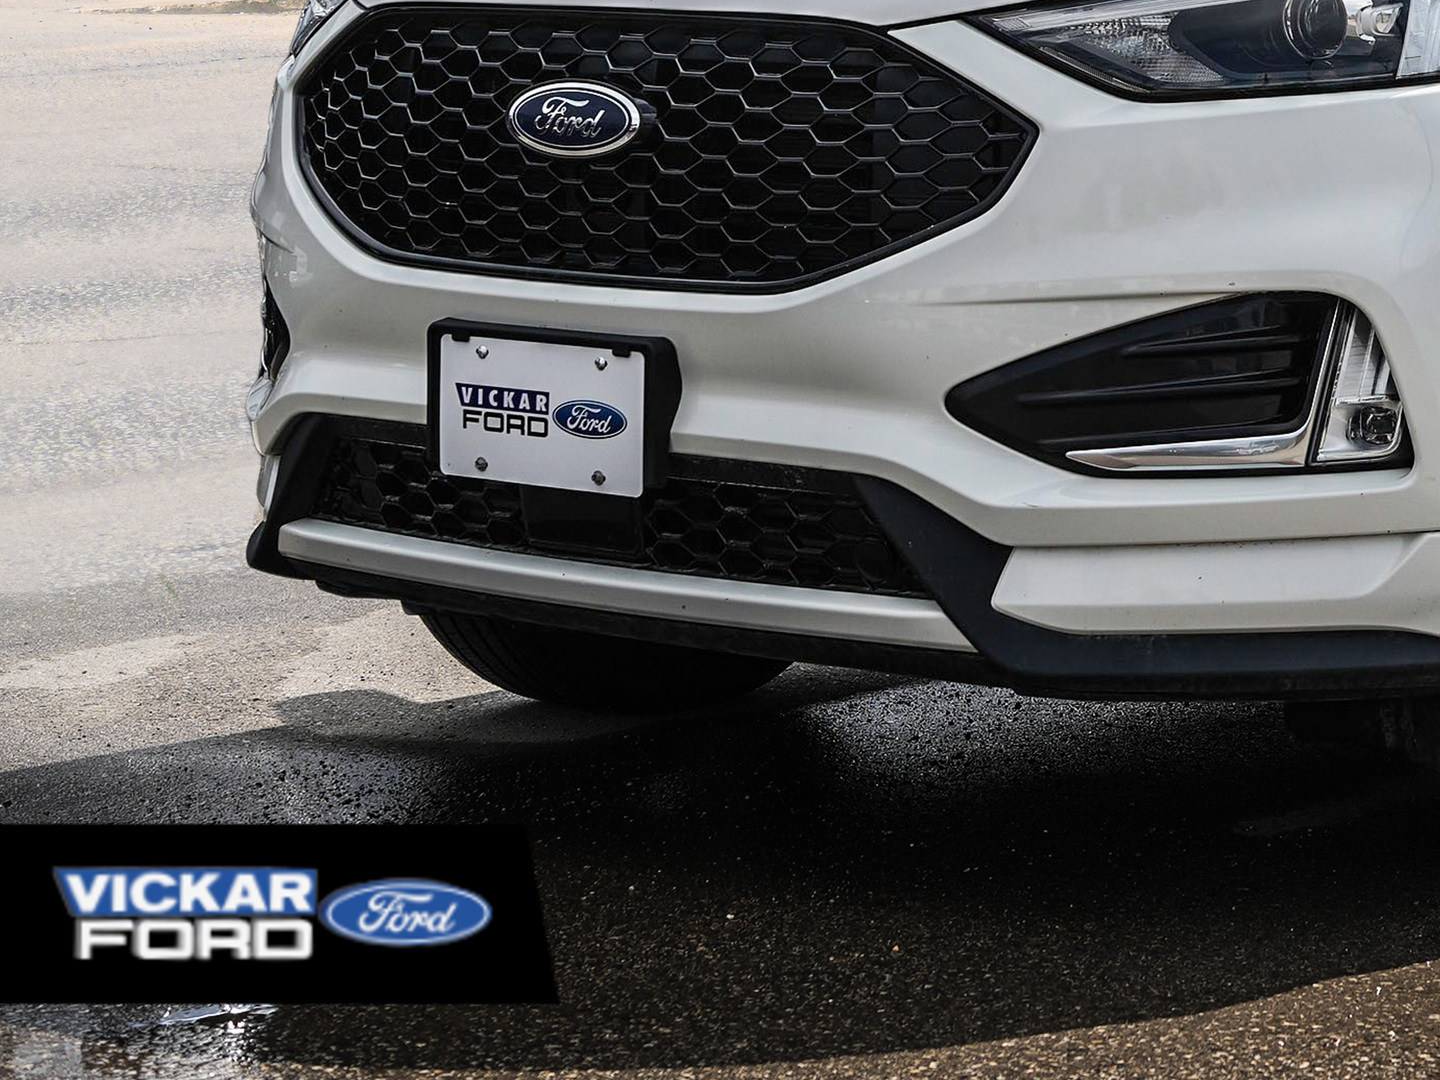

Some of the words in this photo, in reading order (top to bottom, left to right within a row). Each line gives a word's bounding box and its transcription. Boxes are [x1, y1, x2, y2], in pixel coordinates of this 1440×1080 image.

[534, 96, 606, 138] Ford
[460, 386, 548, 412] VICKAR
[462, 409, 549, 438] FORD
[566, 404, 613, 434] Ford
